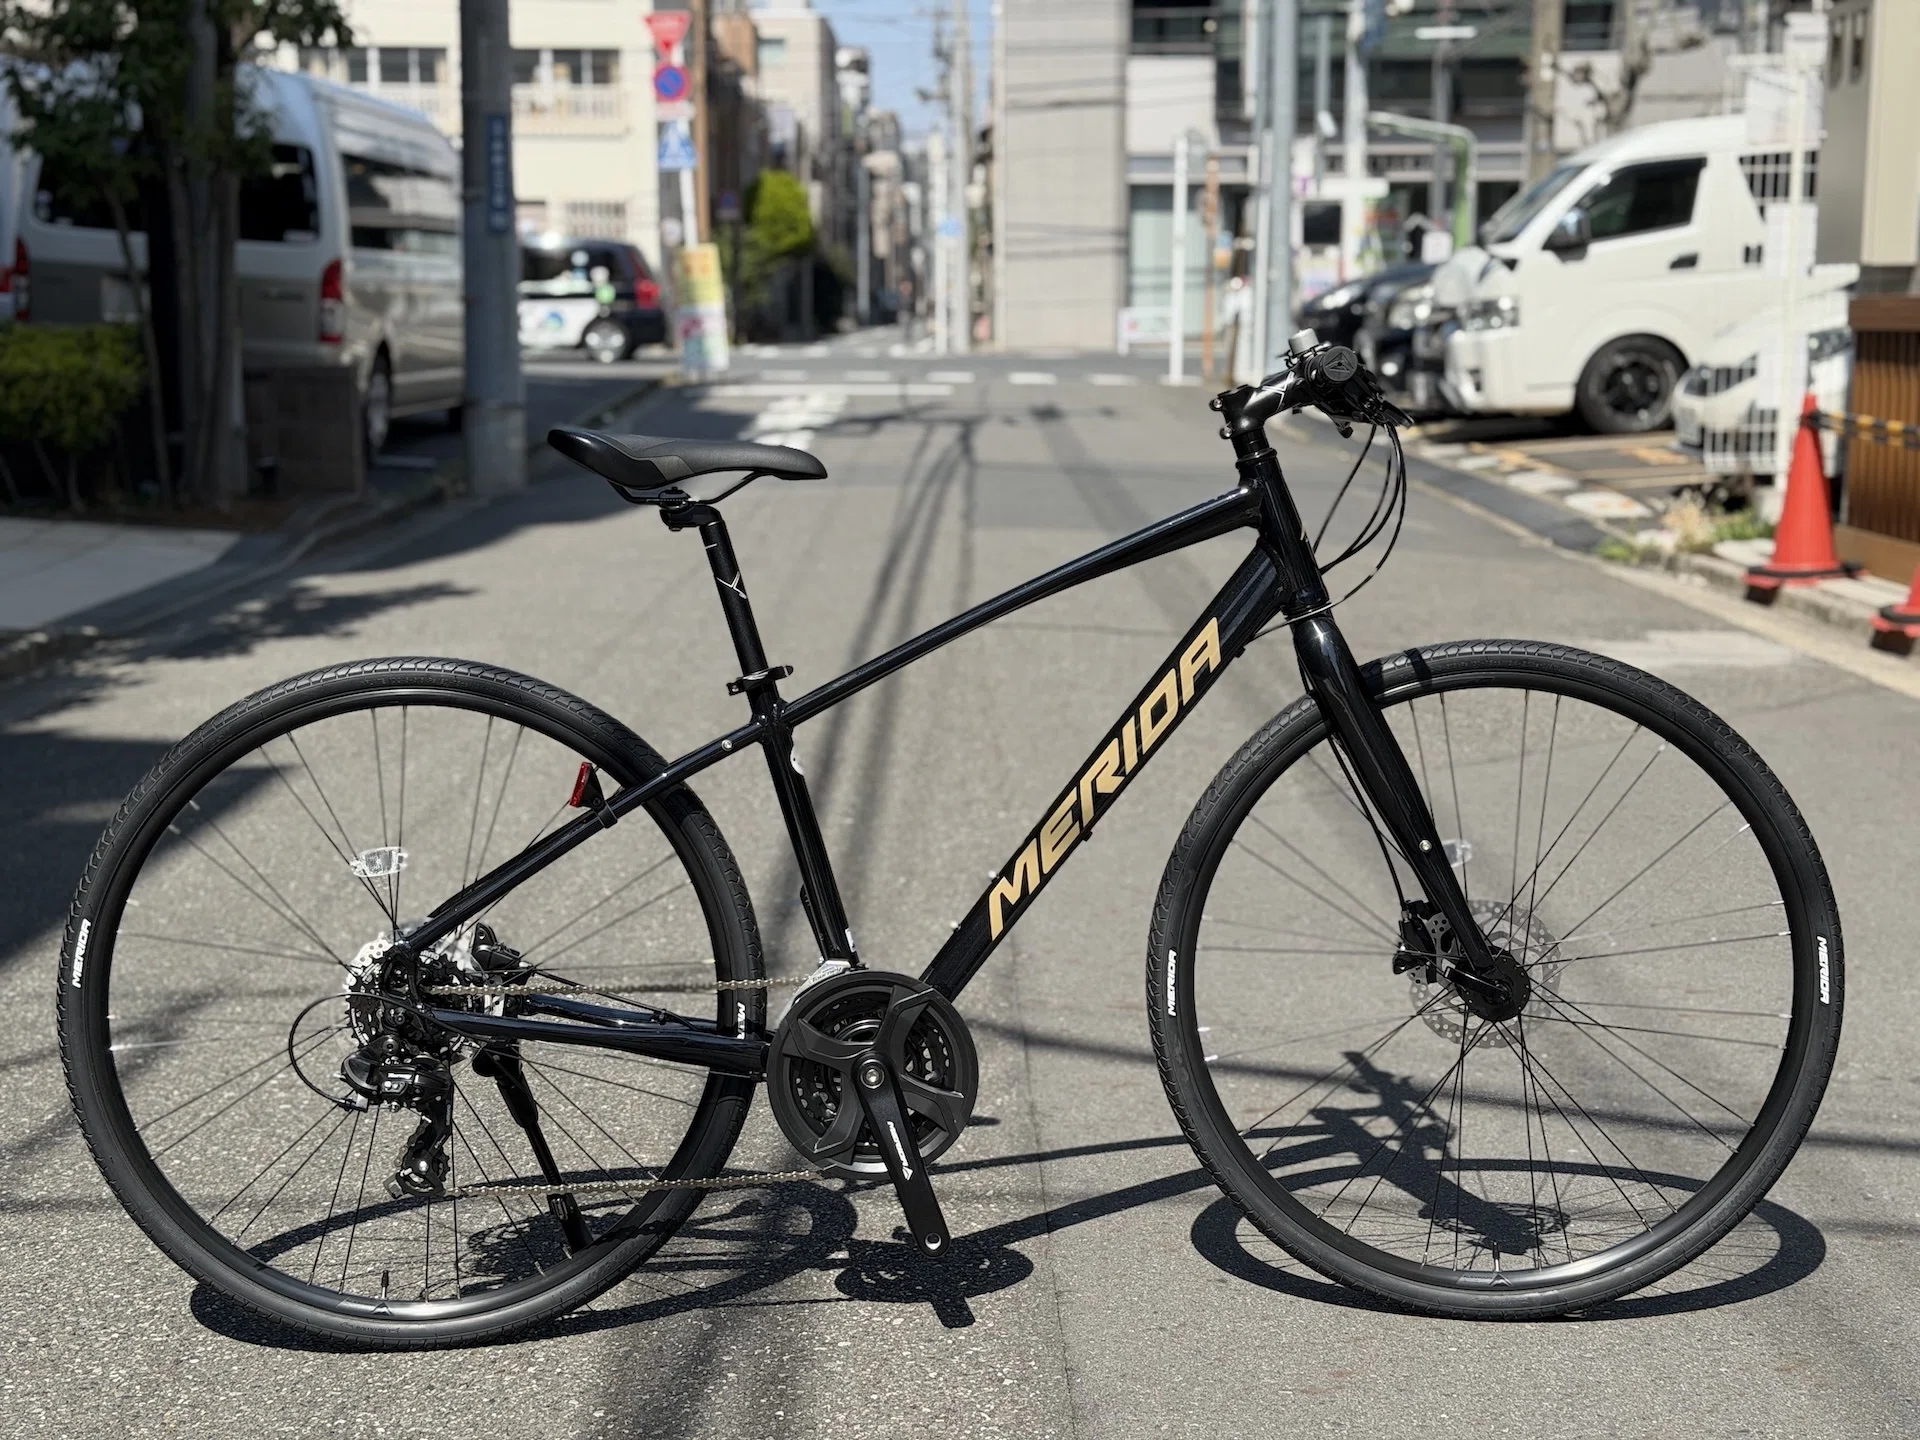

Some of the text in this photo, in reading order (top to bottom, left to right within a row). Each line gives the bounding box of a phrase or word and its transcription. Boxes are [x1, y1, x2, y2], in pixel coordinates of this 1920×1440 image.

[988, 616, 1222, 941] MERIDA
[72, 918, 91, 988] MERIDA
[1167, 949, 1177, 1016] MERIDA
[1817, 935, 1830, 1005] MERIDA
